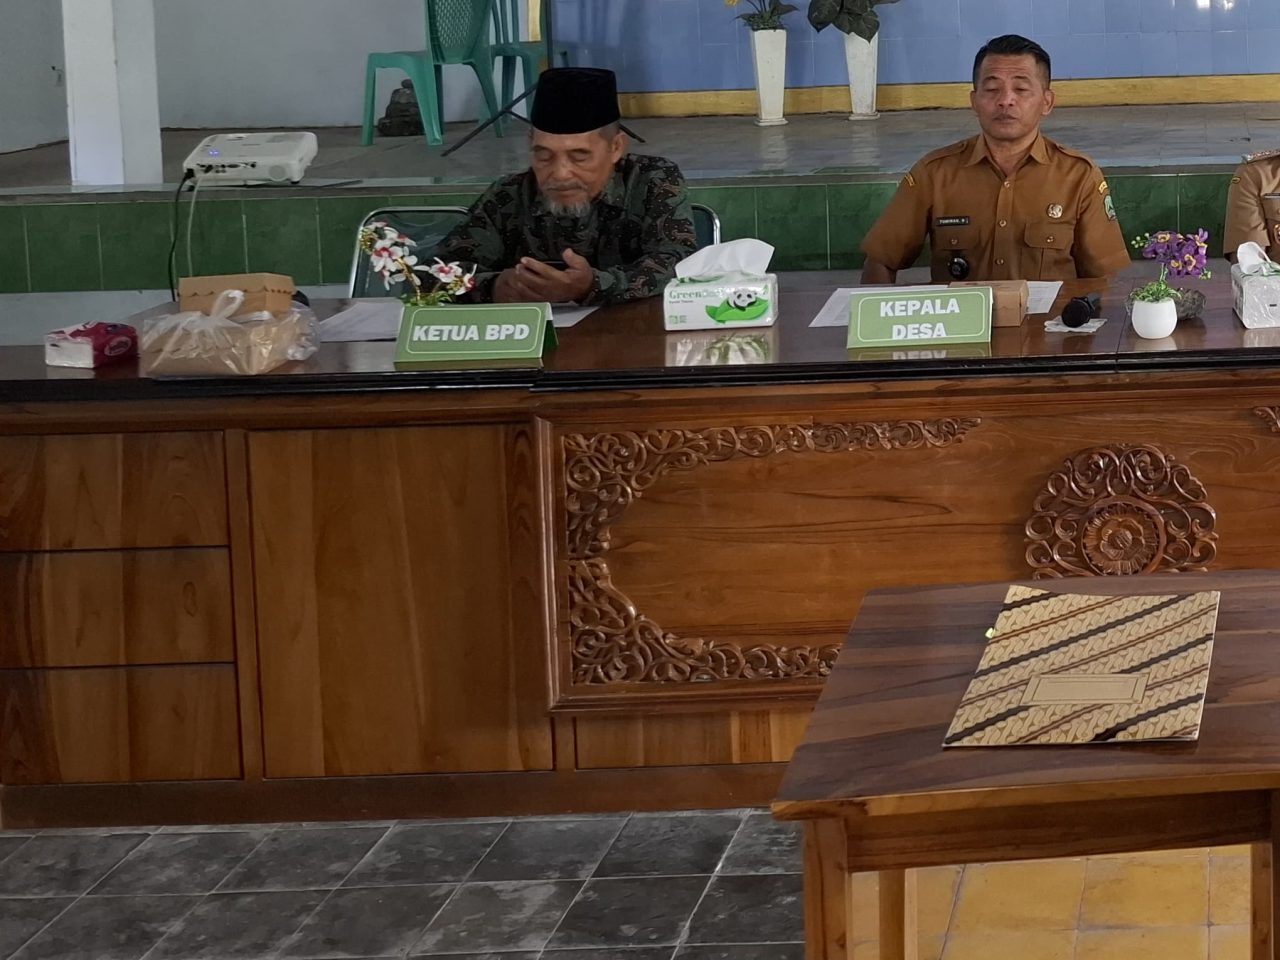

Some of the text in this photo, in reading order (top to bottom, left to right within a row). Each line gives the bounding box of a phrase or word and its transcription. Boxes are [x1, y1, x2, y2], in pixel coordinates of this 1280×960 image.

[880, 298, 960, 317] KEPALA
[413, 324, 530, 341] KETUA BPD
[892, 323, 947, 339] DESA
